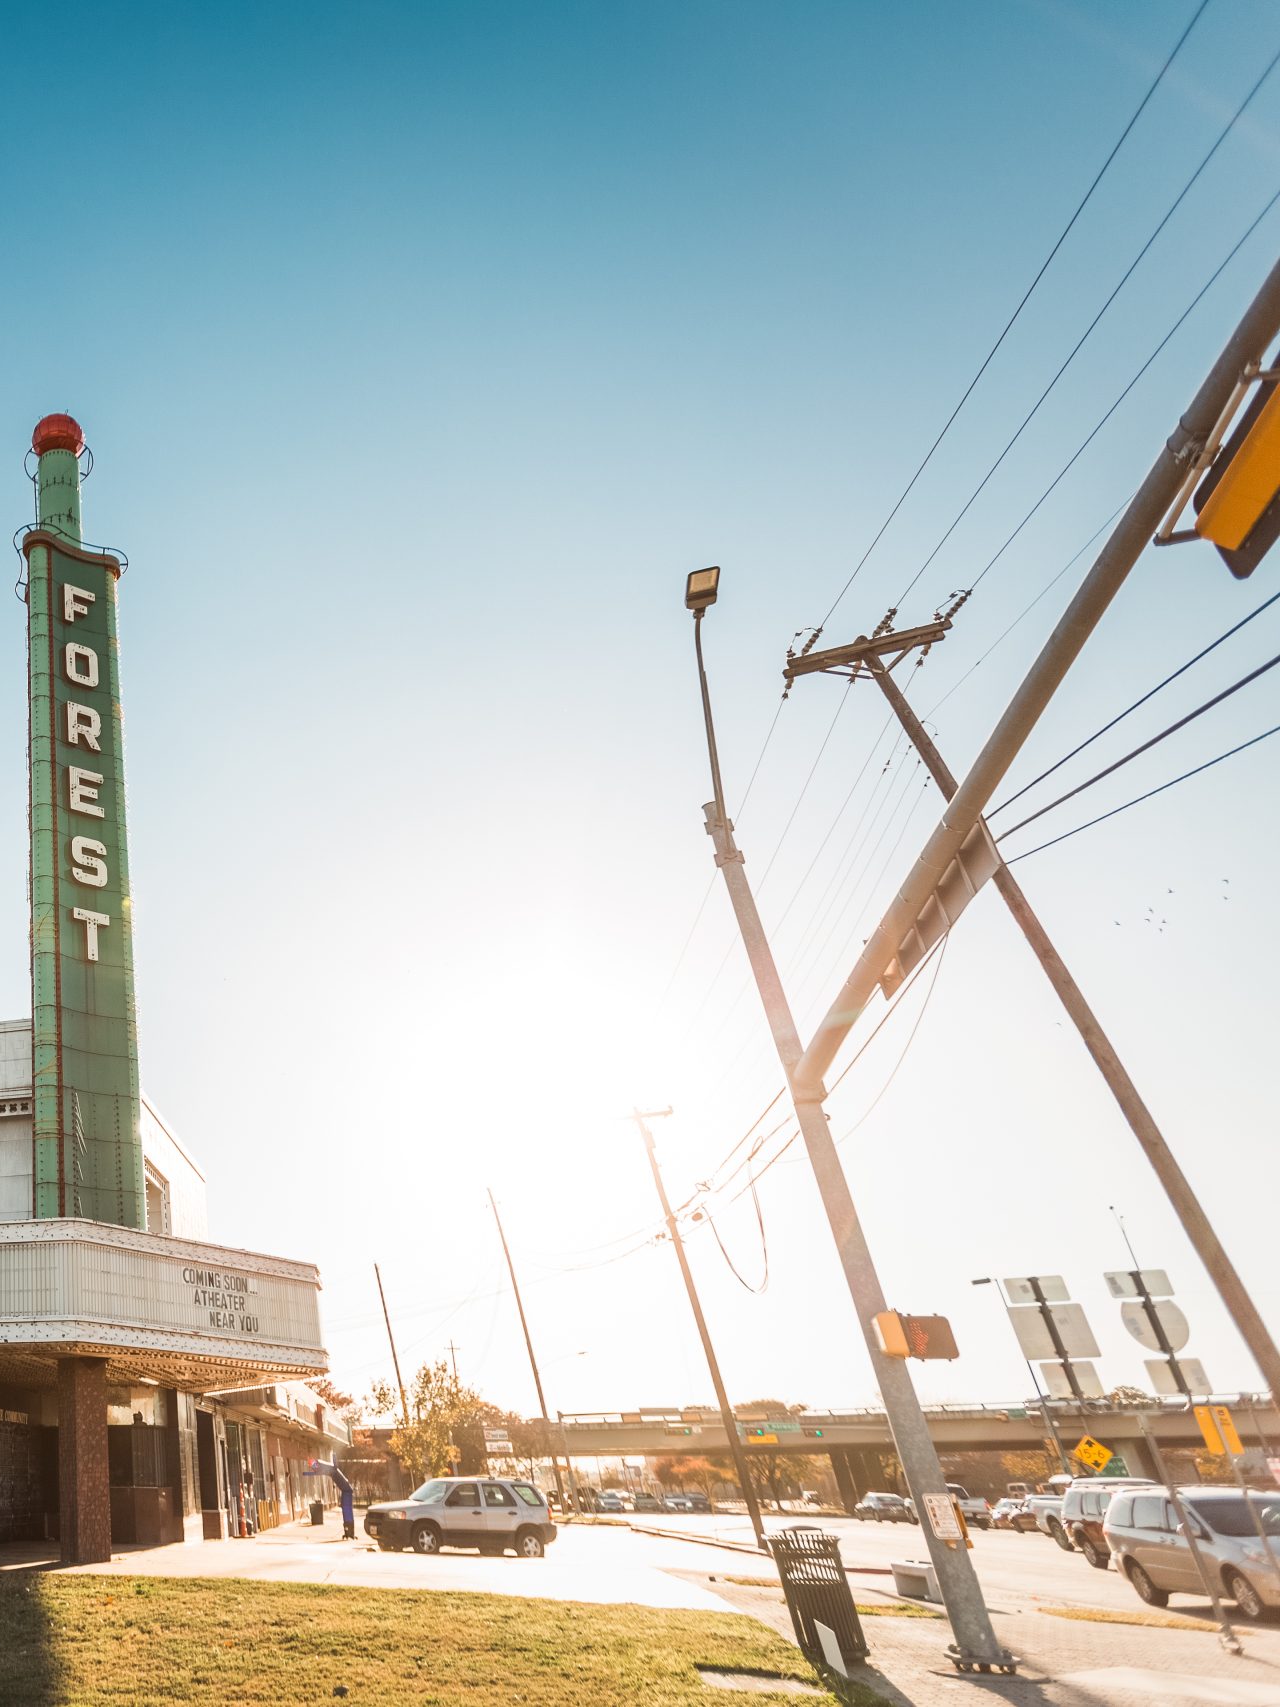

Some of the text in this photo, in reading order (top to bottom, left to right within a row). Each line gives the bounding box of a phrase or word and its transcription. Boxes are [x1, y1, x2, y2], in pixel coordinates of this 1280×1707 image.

[64, 583, 110, 961] FOREST
[182, 1267, 221, 1288] COMING
[209, 1311, 259, 1333] NEAR YOU
